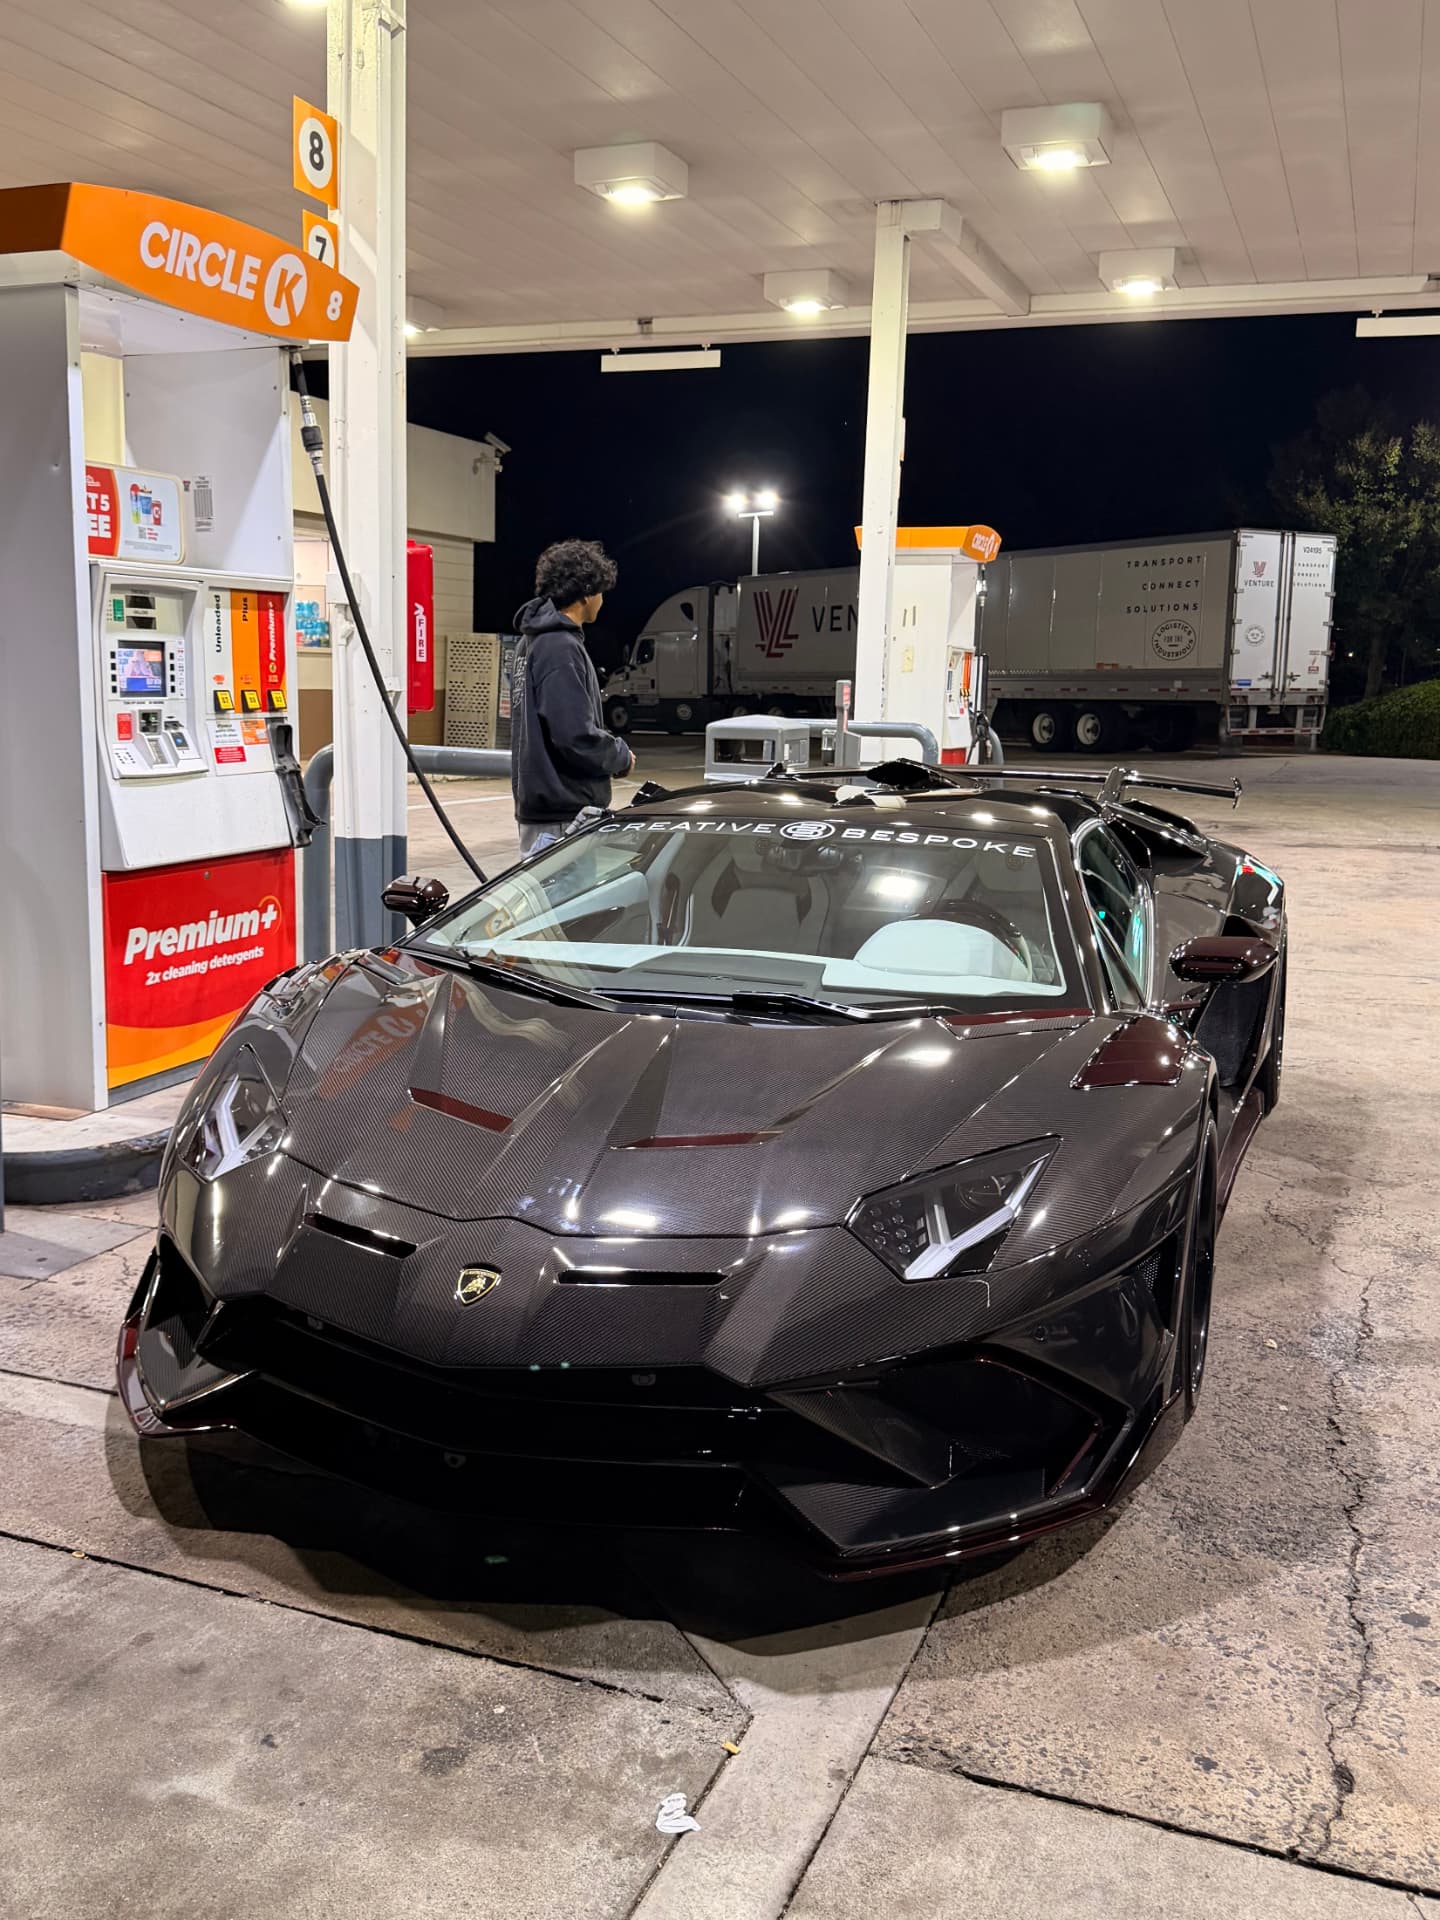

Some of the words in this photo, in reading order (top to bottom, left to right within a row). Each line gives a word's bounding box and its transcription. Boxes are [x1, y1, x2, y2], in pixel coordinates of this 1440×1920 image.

[309, 131, 325, 171] 8
[315, 235, 327, 262] 7
[140, 221, 262, 300] CIRCLE
[267, 257, 306, 326] K
[326, 290, 343, 321] 8
[1126, 555, 1201, 568] TRANSPORT
[1142, 580, 1200, 590] CONNECT
[1244, 579, 1275, 588] VENTURE
[1126, 602, 1199, 614] SOLUTIONS
[214, 594, 222, 653] Unleaded
[1156, 622, 1192, 637] LOGISTICS
[1154, 639, 1194, 658] INDUSTRIOUS
[598, 821, 777, 833] CREATIVE
[841, 828, 1036, 858] BESPOKE
[123, 903, 278, 966] Premium+
[144, 971, 162, 986] 2x
[162, 959, 208, 981] cleaning
[209, 946, 264, 969] detergents
